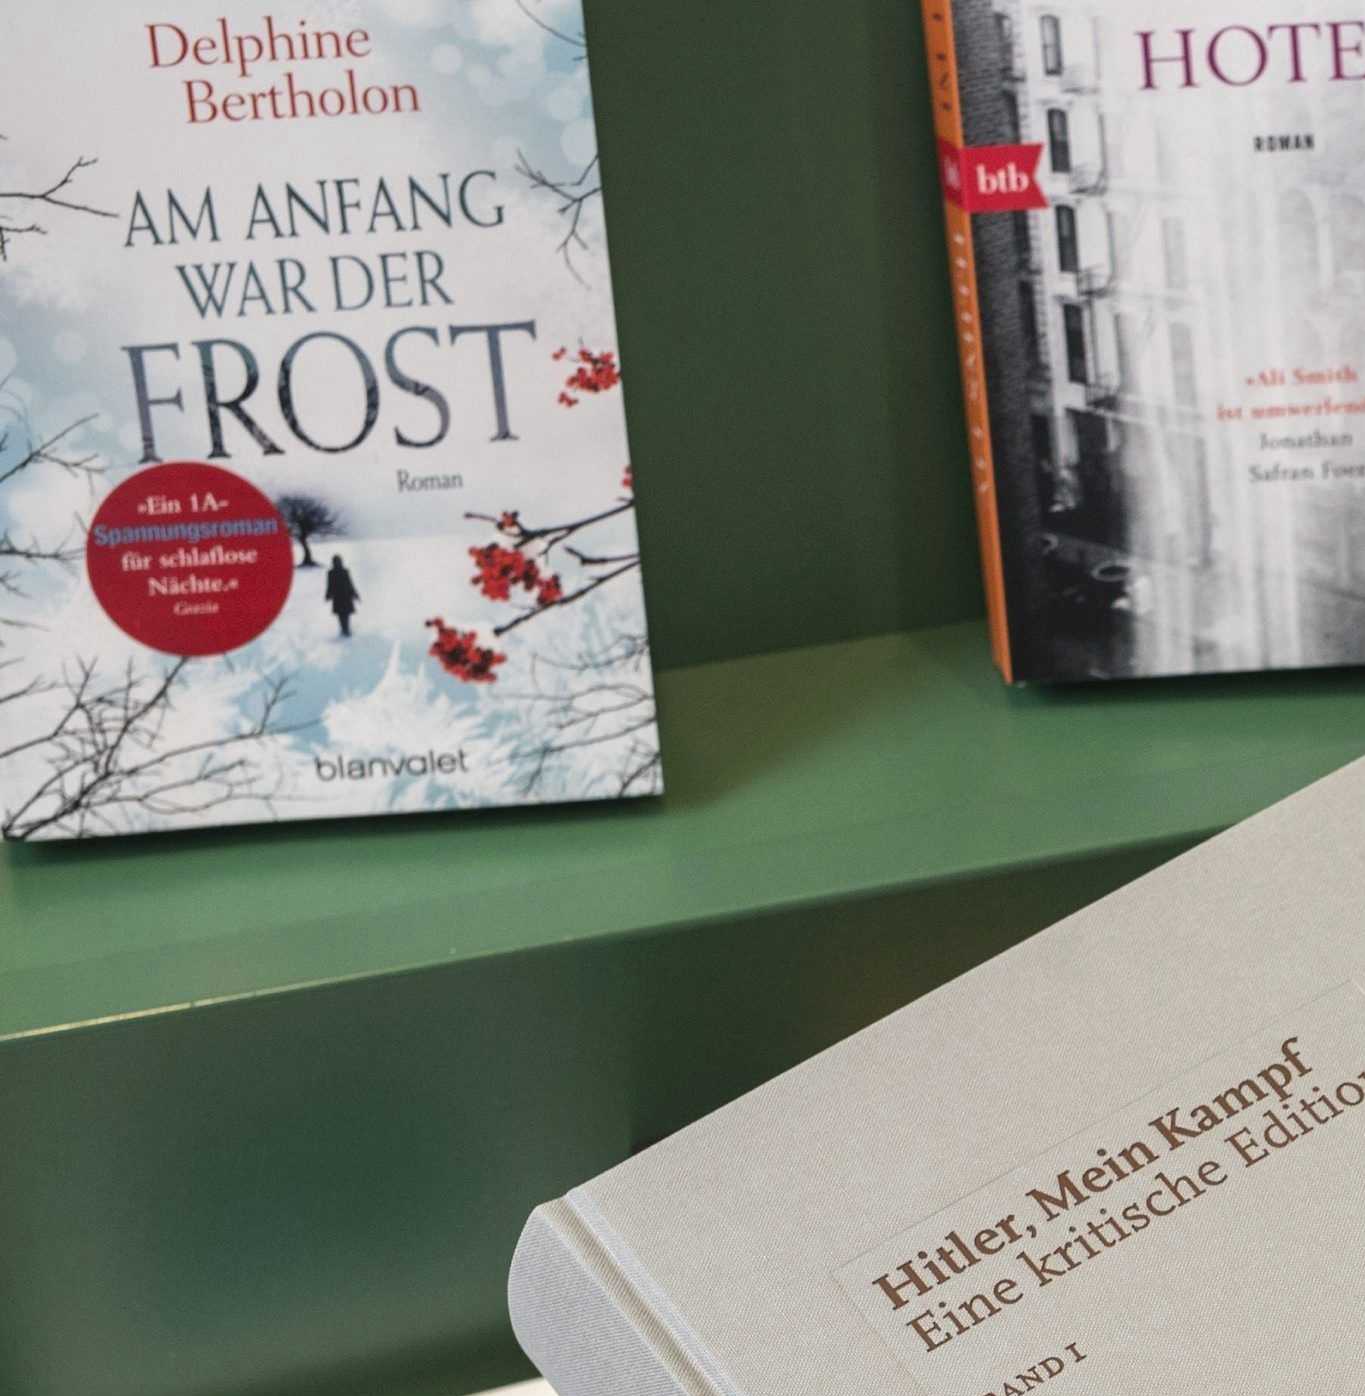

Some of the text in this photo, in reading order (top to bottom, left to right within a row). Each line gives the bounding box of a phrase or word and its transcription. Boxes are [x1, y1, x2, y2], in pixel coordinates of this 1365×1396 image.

[145, 15, 372, 78] Delphine
[182, 70, 422, 124] Bertholon
[1253, 133, 1316, 153] ROMAN
[976, 162, 1030, 194] btb
[124, 169, 504, 248] AM ANFANG
[175, 250, 454, 319] WAR DER
[1293, 364, 1359, 385] Smith
[120, 319, 538, 464] FROST
[1216, 402, 1243, 421] ist
[1261, 429, 1353, 450] Jonathan
[396, 469, 464, 494] Roman
[1249, 460, 1314, 482] Safran
[94, 518, 279, 549] Spannungsroman
[122, 545, 258, 571] für schlaflose
[315, 746, 471, 784] blanvalet
[872, 1036, 1314, 1311] Hitler, Mein Kampf
[906, 1277, 1024, 1353] Eine
[1016, 1160, 1229, 1287] kritische
[1065, 1342, 1088, 1364] I
